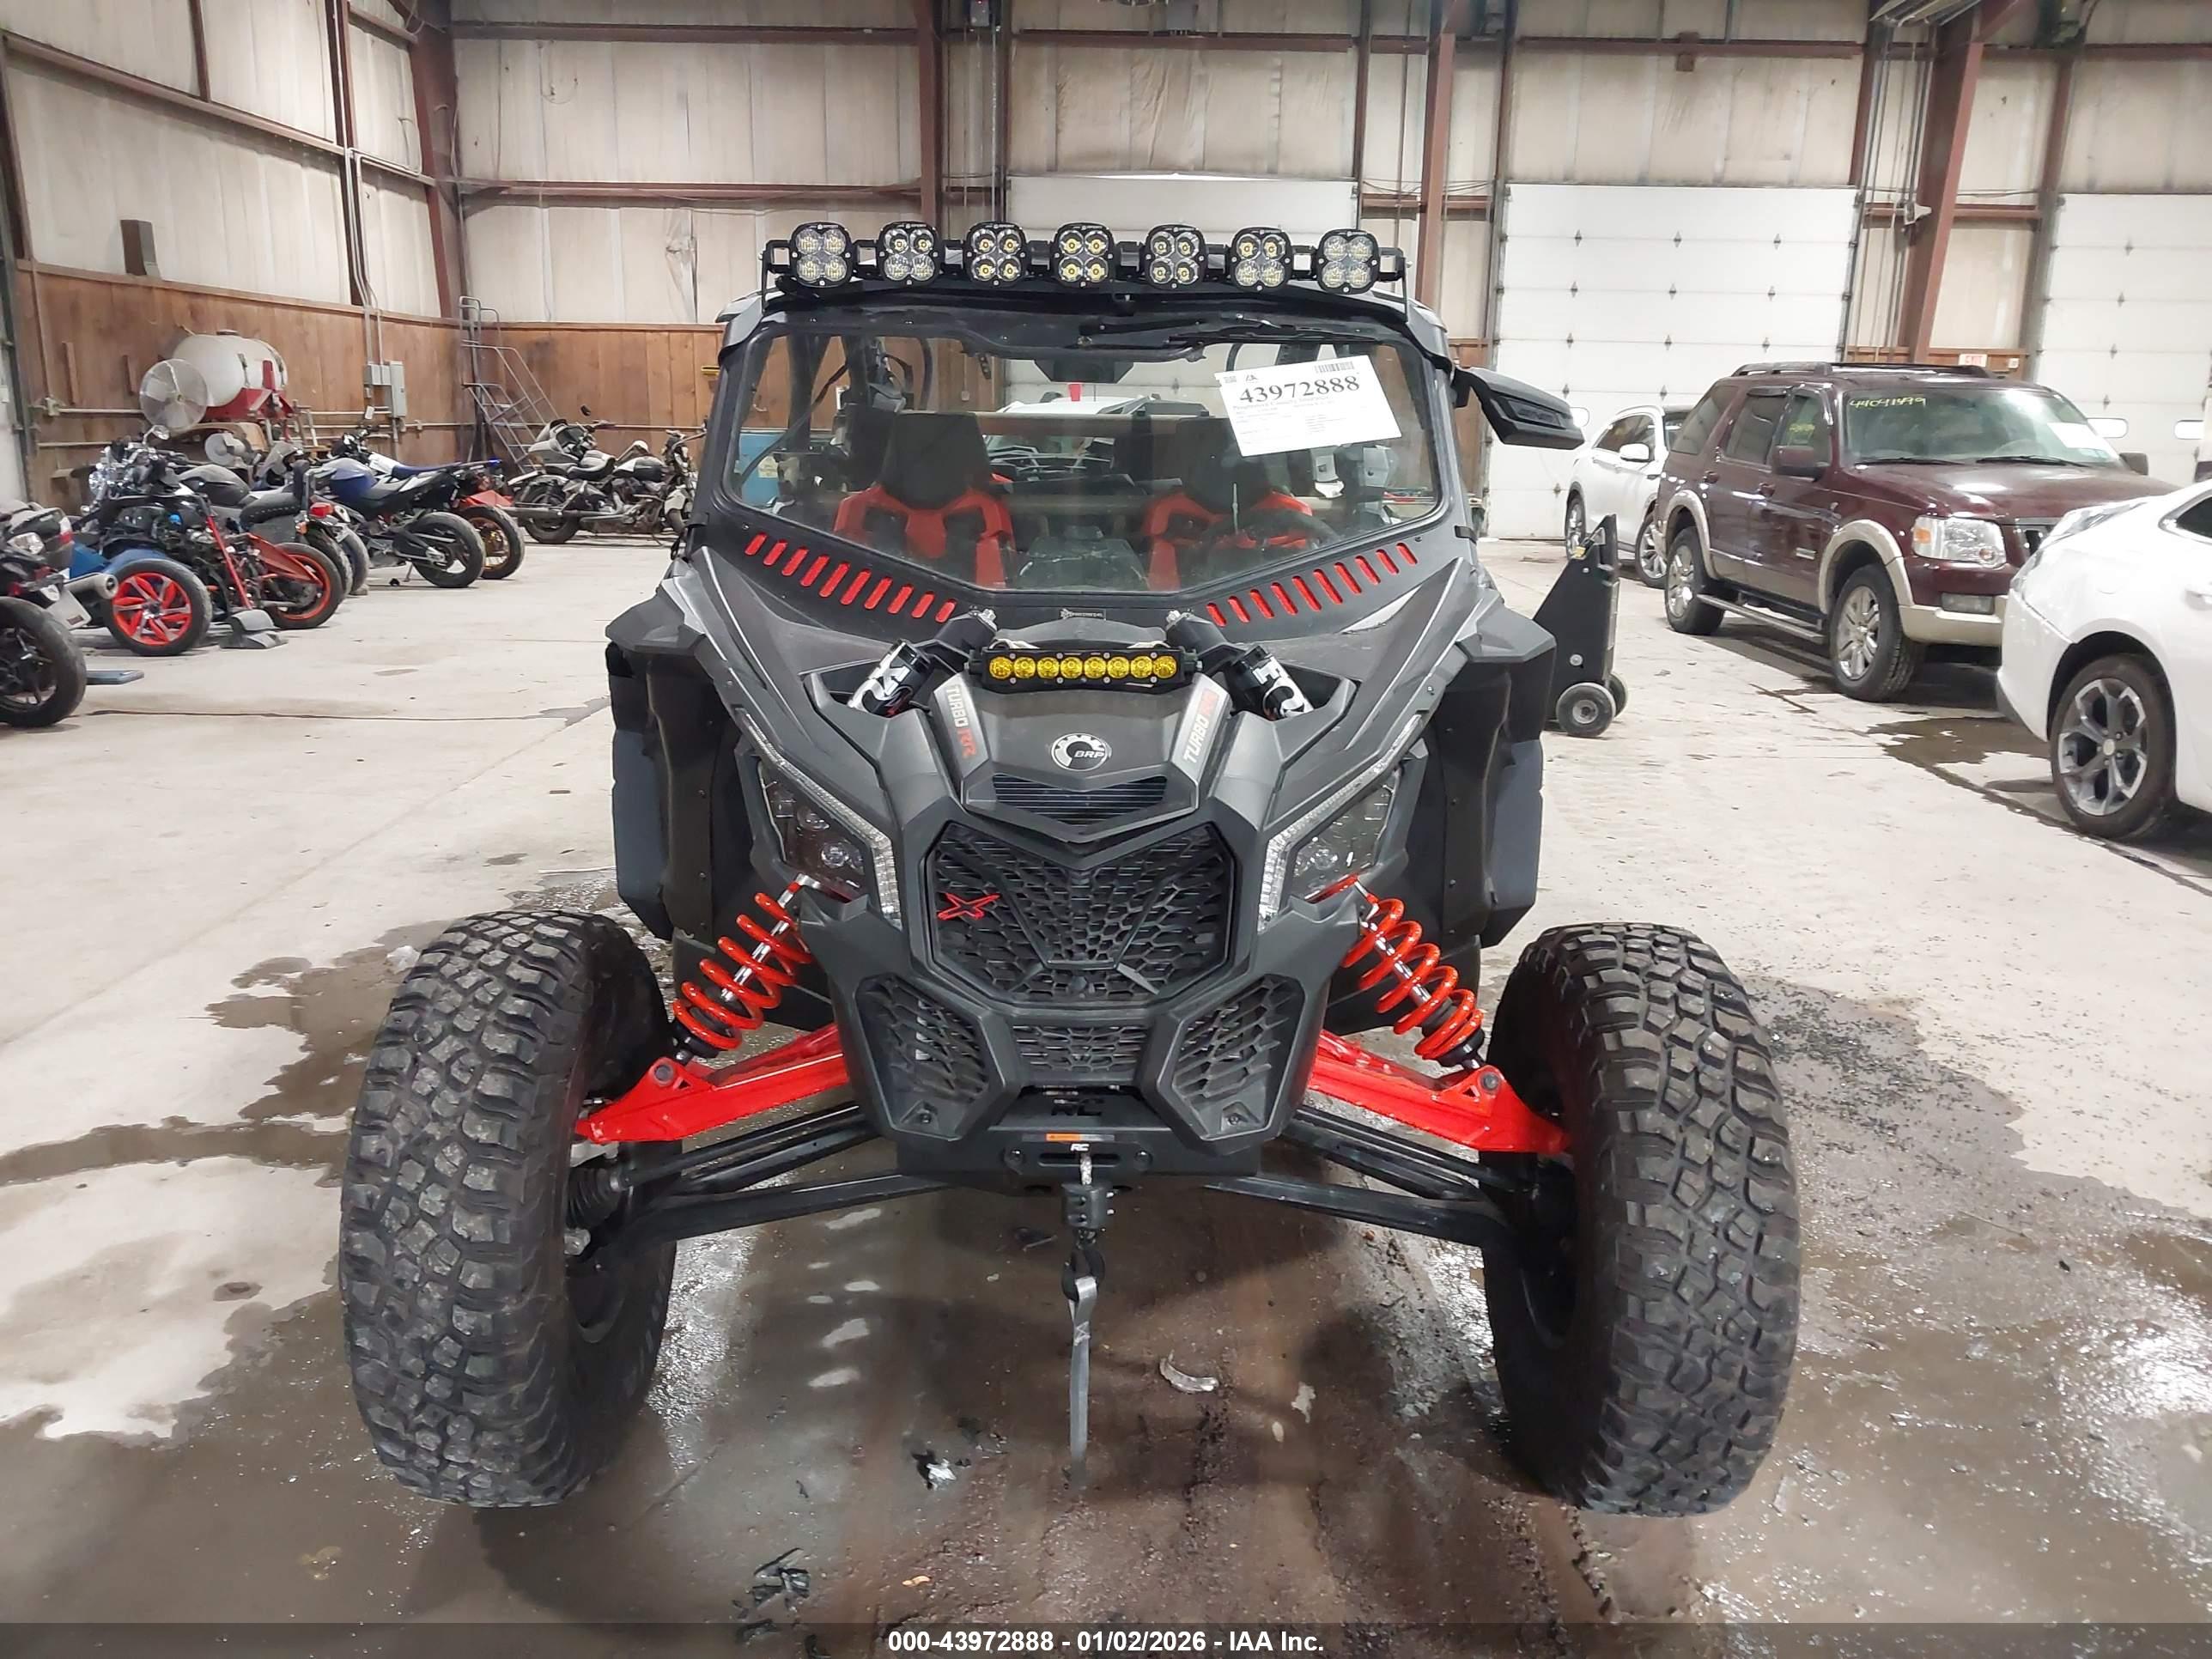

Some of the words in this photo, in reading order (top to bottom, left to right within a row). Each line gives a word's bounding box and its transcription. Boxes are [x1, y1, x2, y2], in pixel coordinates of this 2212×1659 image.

[1239, 375, 1360, 404] 43972888
[946, 685, 969, 727] TURBO
[1183, 714, 1210, 763] TURBO
[1074, 750, 1105, 758] BRP
[1070, 1143, 1090, 1152] RC
